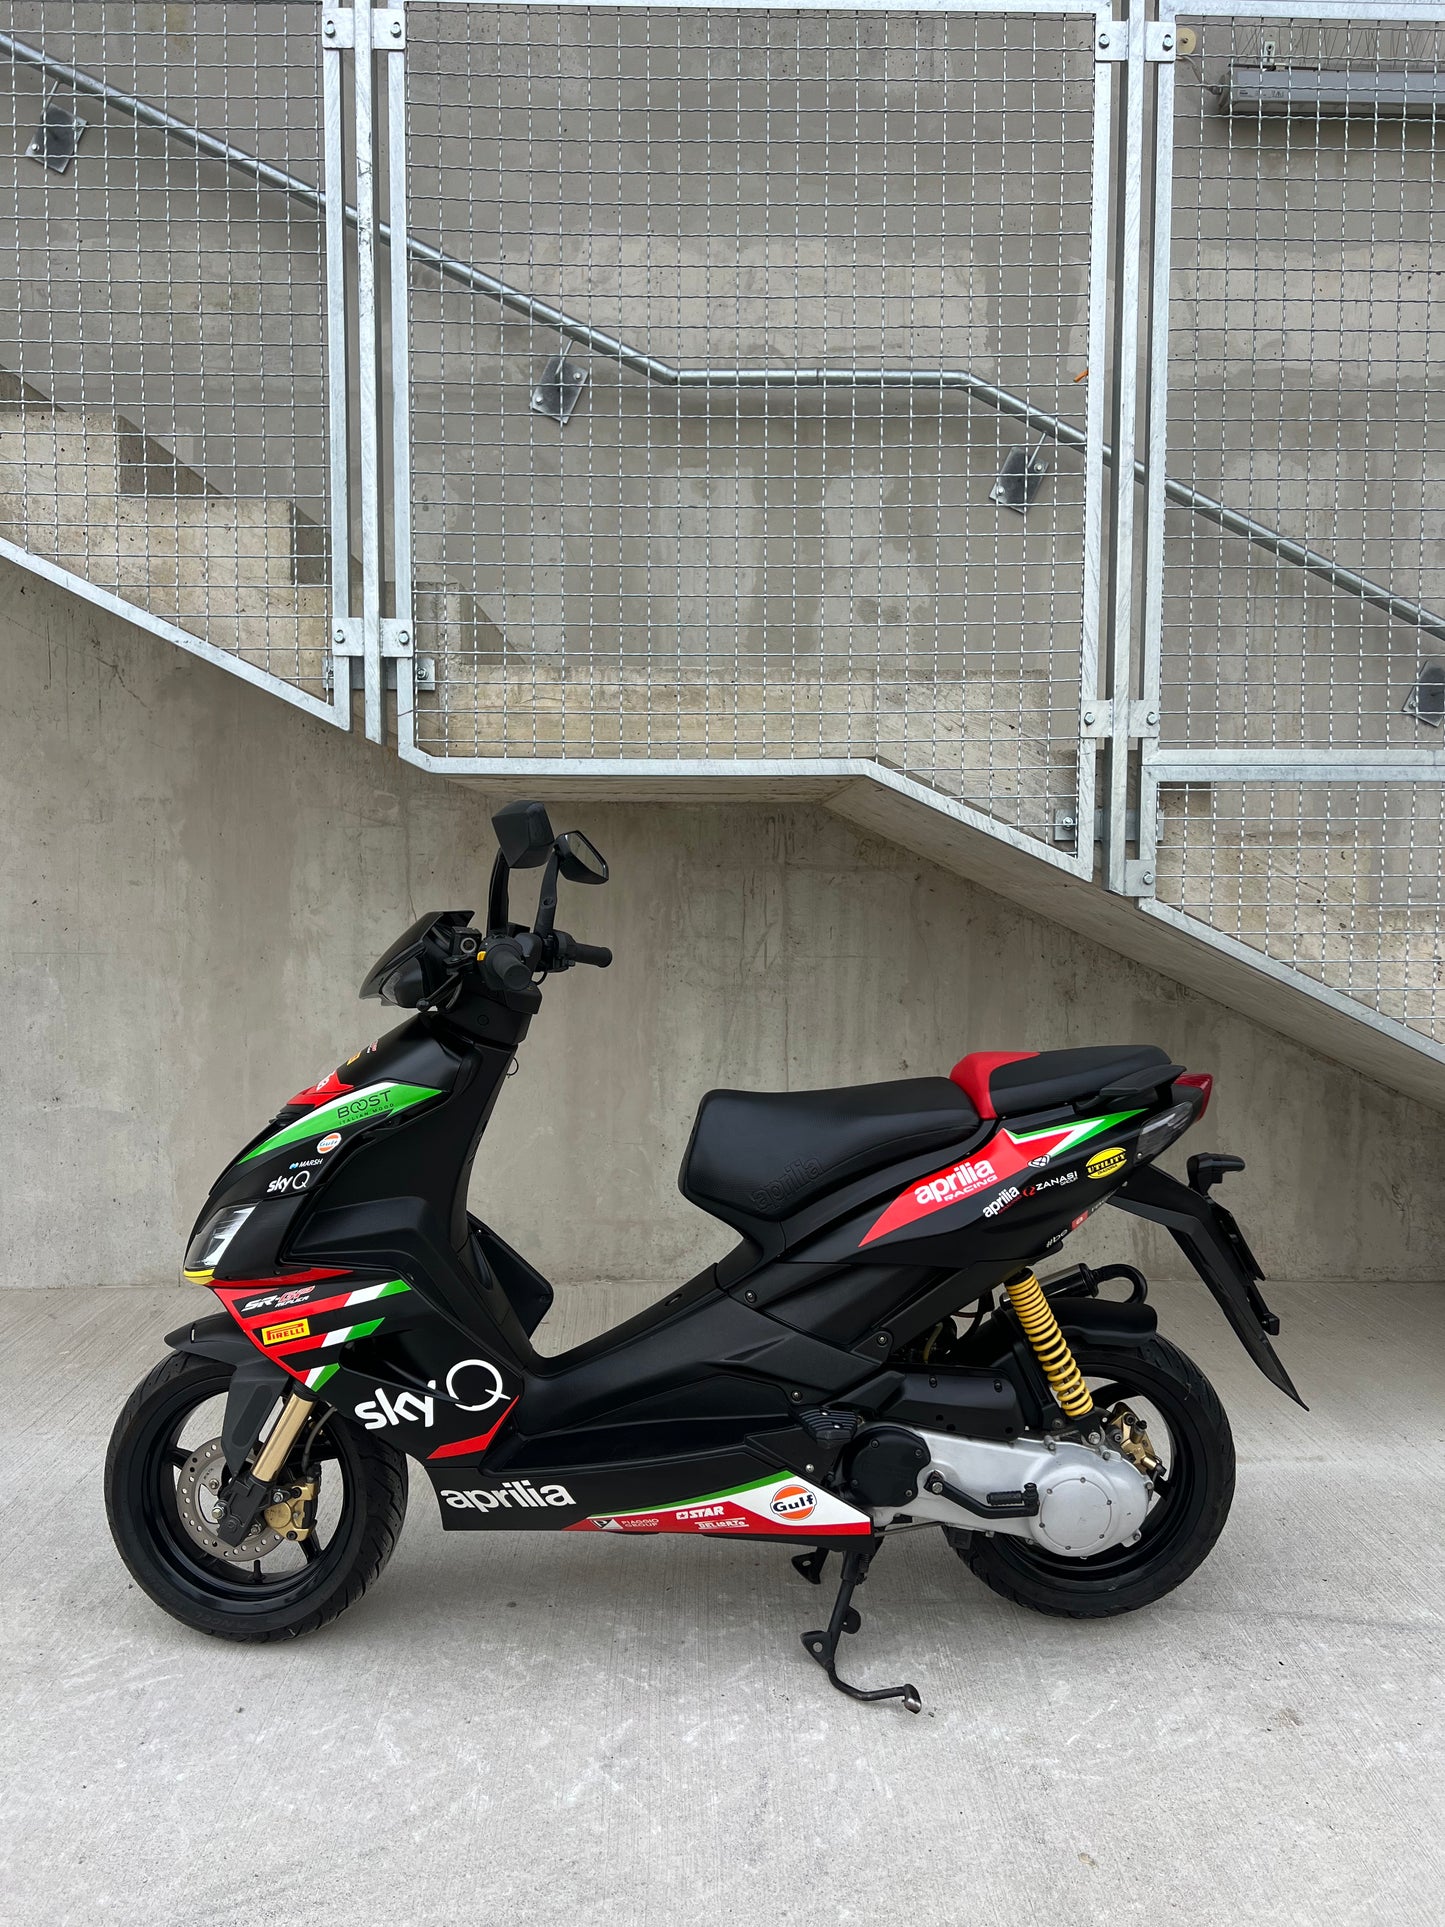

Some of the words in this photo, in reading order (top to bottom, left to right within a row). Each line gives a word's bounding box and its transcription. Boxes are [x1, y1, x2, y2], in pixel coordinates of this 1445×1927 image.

[337, 1090, 391, 1118] BOOST
[299, 1158, 324, 1168] MARSH
[1087, 1153, 1126, 1173] UTILITY
[266, 1175, 294, 1193] sky
[914, 1160, 995, 1205] aprilia
[944, 1175, 998, 1202] RACING
[1036, 1171, 1078, 1191] ZANASI
[983, 1186, 1021, 1218] aprilia
[266, 1322, 305, 1341] PIRELLI
[354, 1379, 437, 1430] sky
[445, 1359, 512, 1412] Q
[440, 1479, 577, 1513] aprilia
[772, 1494, 815, 1512] Gulf
[621, 1518, 660, 1526] PIAGGIO
